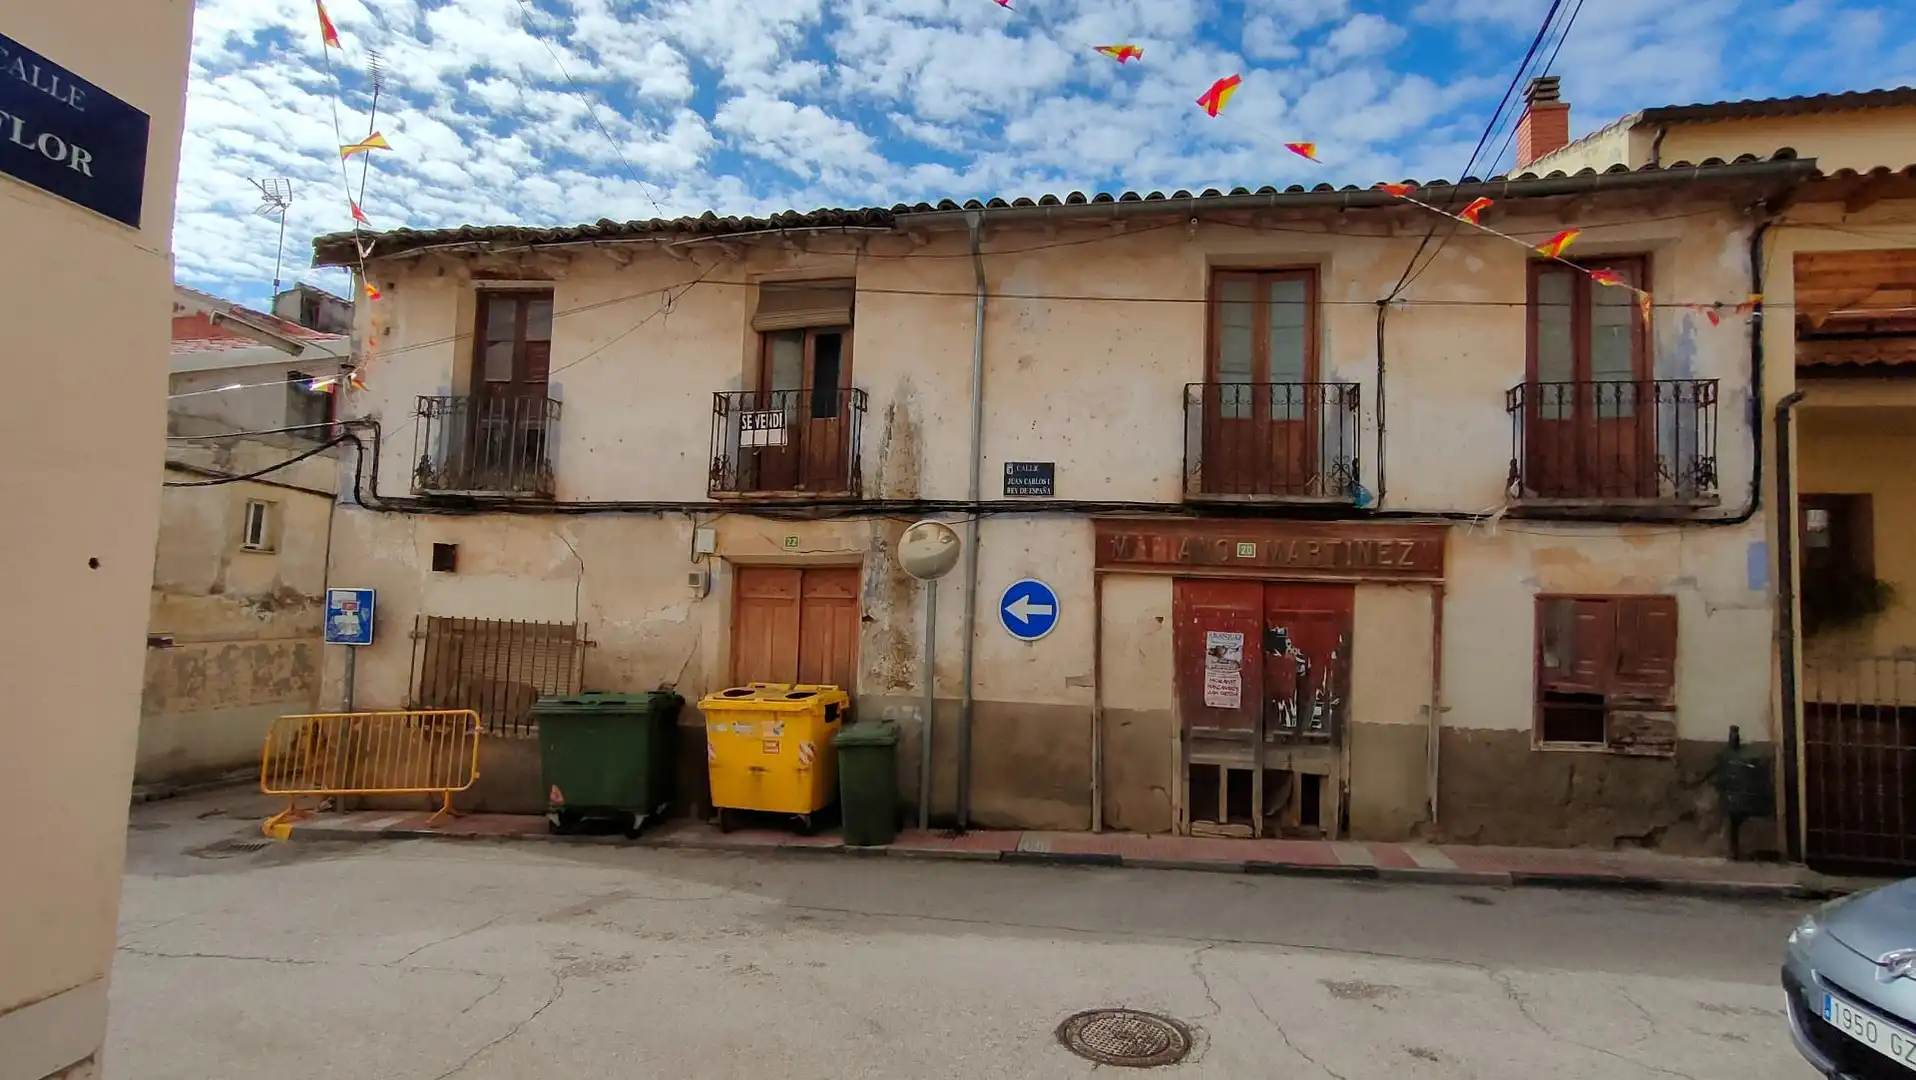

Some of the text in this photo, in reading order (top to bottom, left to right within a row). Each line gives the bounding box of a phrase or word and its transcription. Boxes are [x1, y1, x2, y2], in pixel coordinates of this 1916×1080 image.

[741, 413, 753, 430] SE
[1016, 464, 1039, 472] CALLE
[1007, 477, 1023, 485] JUAN
[1023, 477, 1047, 485] CARLOS
[1028, 486, 1051, 495] ESPAÑA
[786, 536, 798, 546] 22
[1111, 535, 1229, 562] MIANO
[1240, 544, 1252, 555] 20
[1834, 1003, 1877, 1044] 1950
